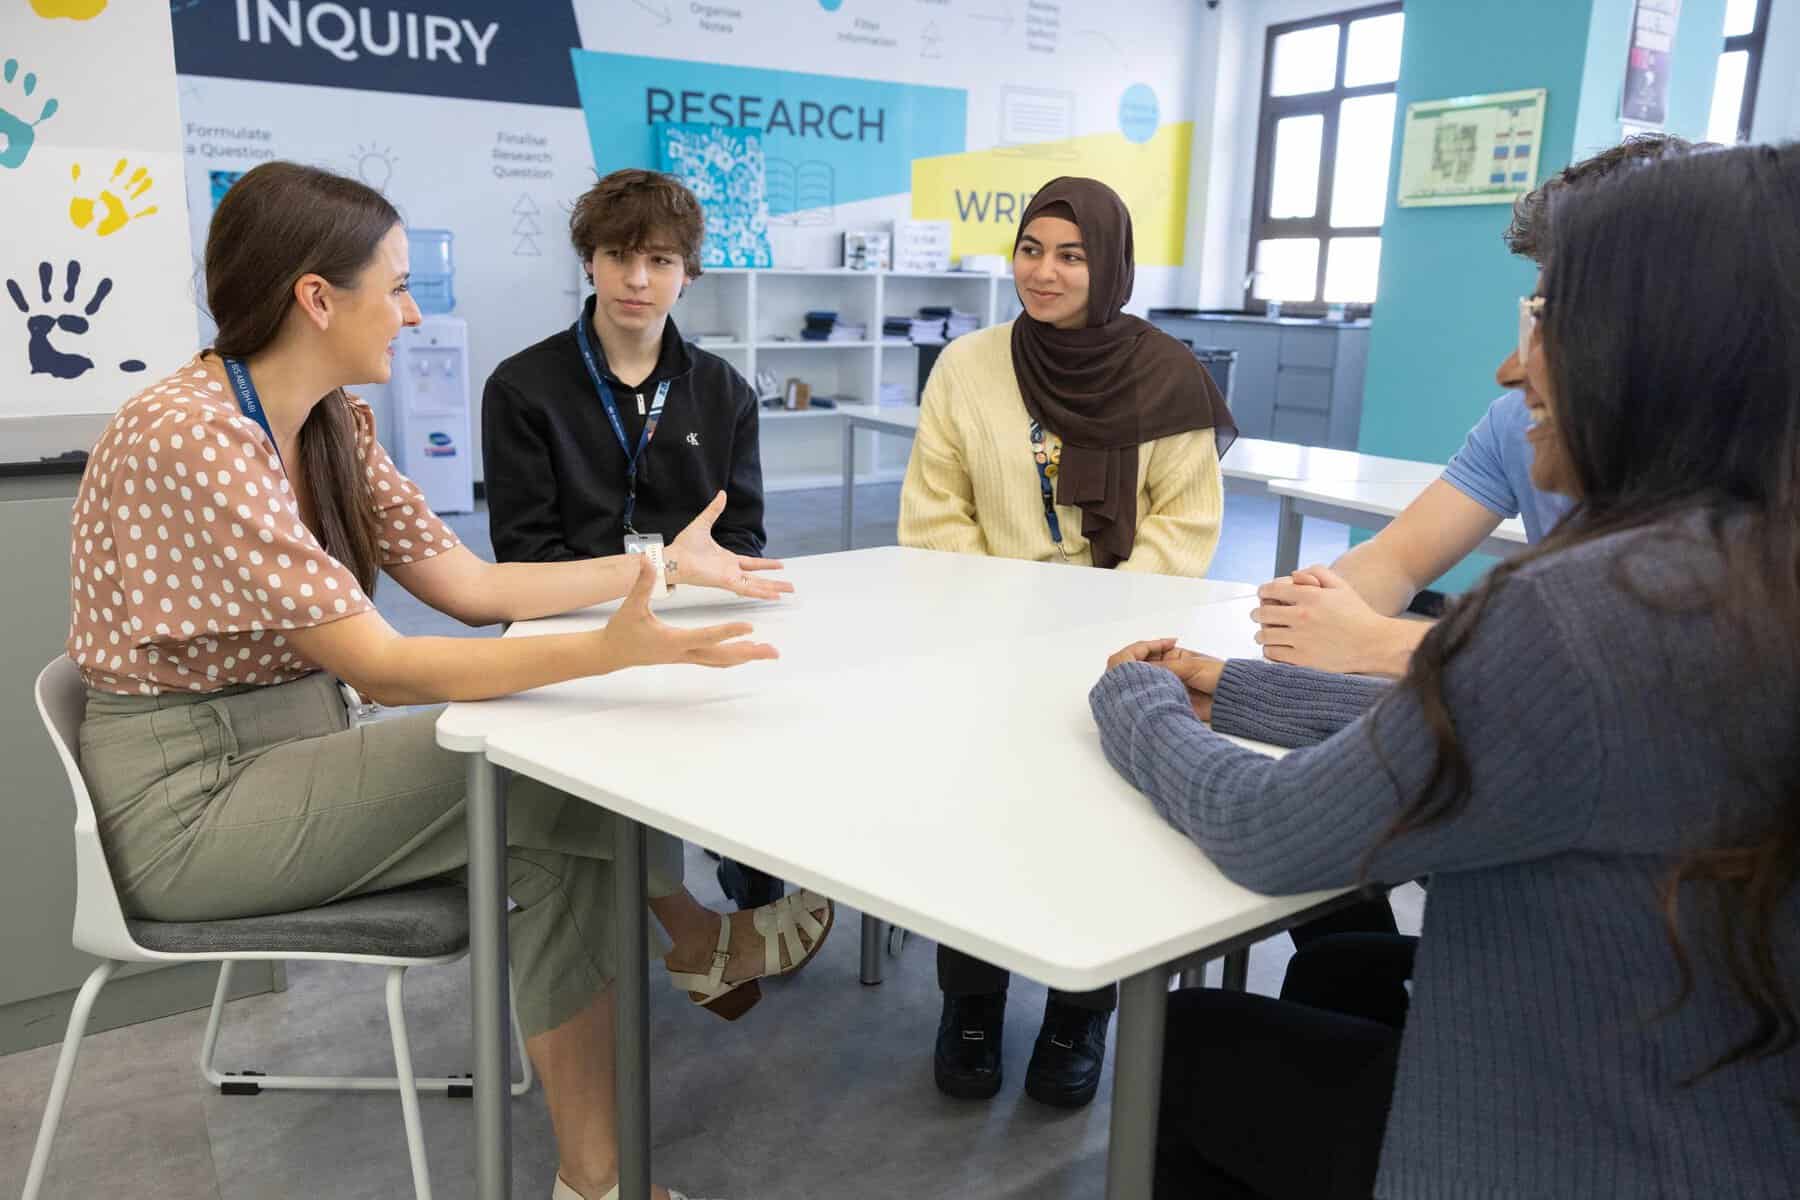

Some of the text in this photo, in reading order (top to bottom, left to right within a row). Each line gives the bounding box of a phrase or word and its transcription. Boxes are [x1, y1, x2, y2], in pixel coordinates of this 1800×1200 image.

[236, 0, 499, 65] INQUIRY
[645, 86, 885, 143] RESEARCH
[187, 122, 272, 141] Formulate
[200, 143, 274, 160] Question
[493, 165, 552, 179] Question
[955, 189, 1034, 224] WRI
